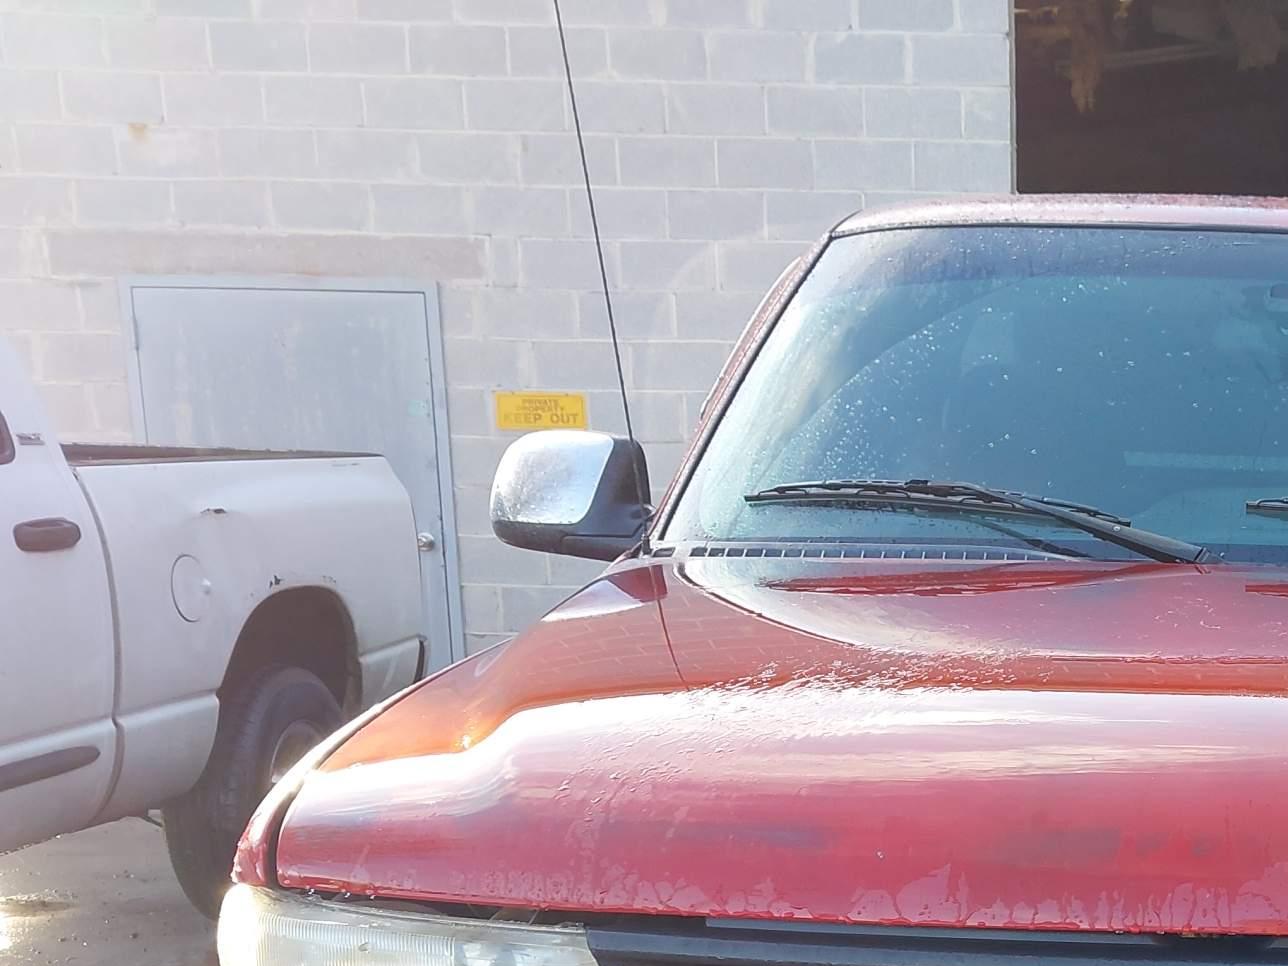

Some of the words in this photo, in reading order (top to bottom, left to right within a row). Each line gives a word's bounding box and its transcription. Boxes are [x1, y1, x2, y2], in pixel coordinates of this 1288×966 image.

[520, 398, 561, 407] PRIVATE
[515, 404, 565, 413] PROPERTY
[503, 412, 543, 425] KEEP
[550, 412, 580, 425] OUT
